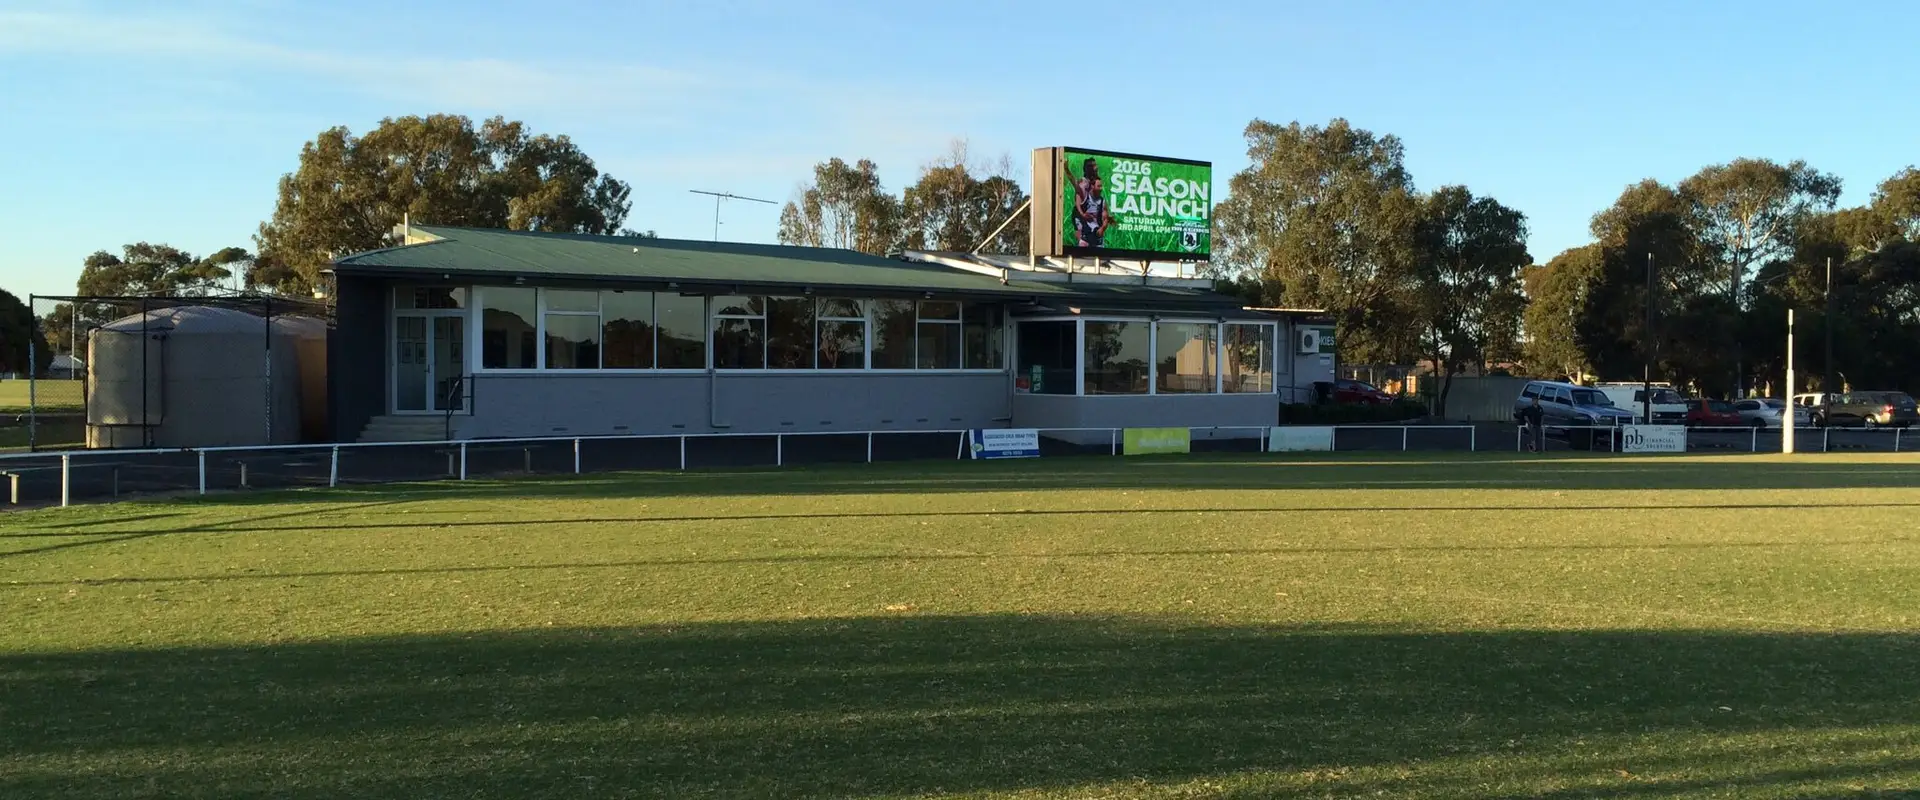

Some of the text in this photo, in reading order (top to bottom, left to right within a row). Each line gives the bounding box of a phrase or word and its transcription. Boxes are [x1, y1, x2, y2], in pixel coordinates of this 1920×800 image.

[1112, 160, 1151, 175] 2016
[1111, 174, 1208, 201] SEASON
[1110, 193, 1208, 219] LAUNCH
[1118, 223, 1133, 231] 2ND
[1134, 224, 1155, 233] APRIL
[1156, 226, 1171, 234] 6PM
[1123, 216, 1166, 226] SATURDAY
[1625, 429, 1644, 448] pb
